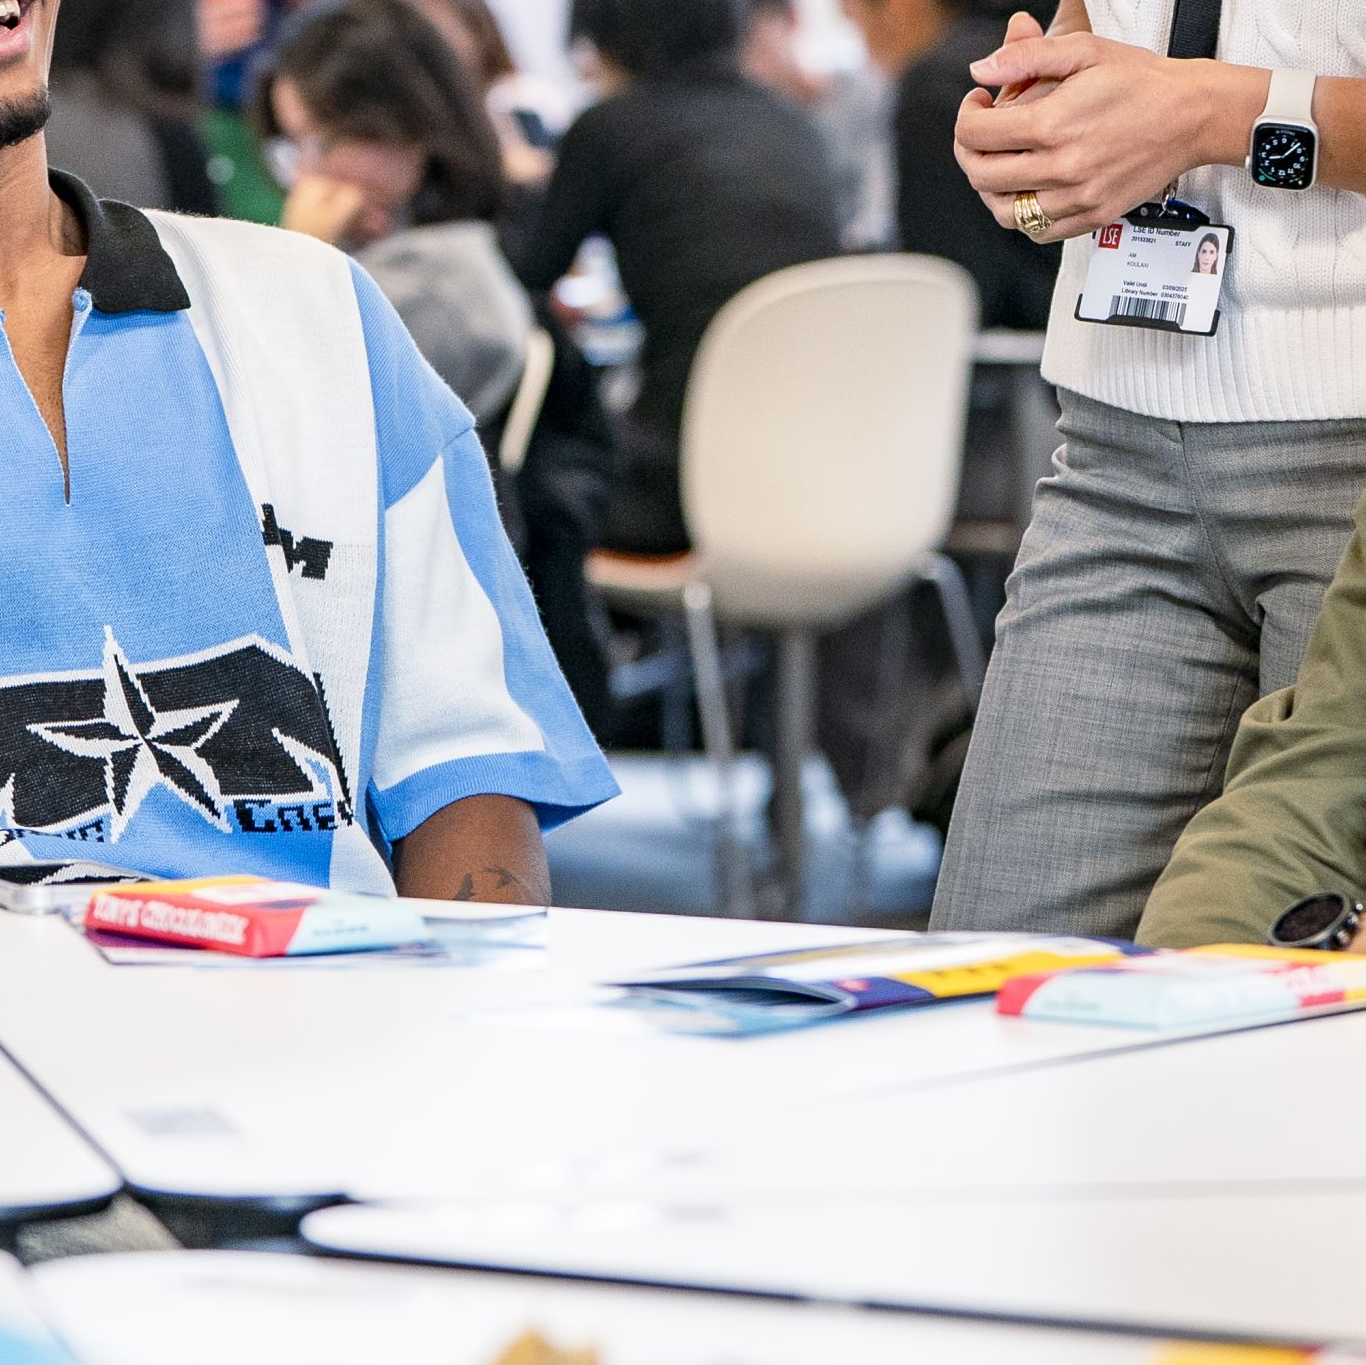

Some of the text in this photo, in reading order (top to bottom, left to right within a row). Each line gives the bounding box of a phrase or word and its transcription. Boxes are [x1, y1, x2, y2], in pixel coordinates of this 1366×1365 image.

[1102, 226, 1119, 245] LSE
[1133, 226, 1147, 234] LSE
[1155, 228, 1181, 237] Number
[1121, 287, 1158, 297] Library Number
